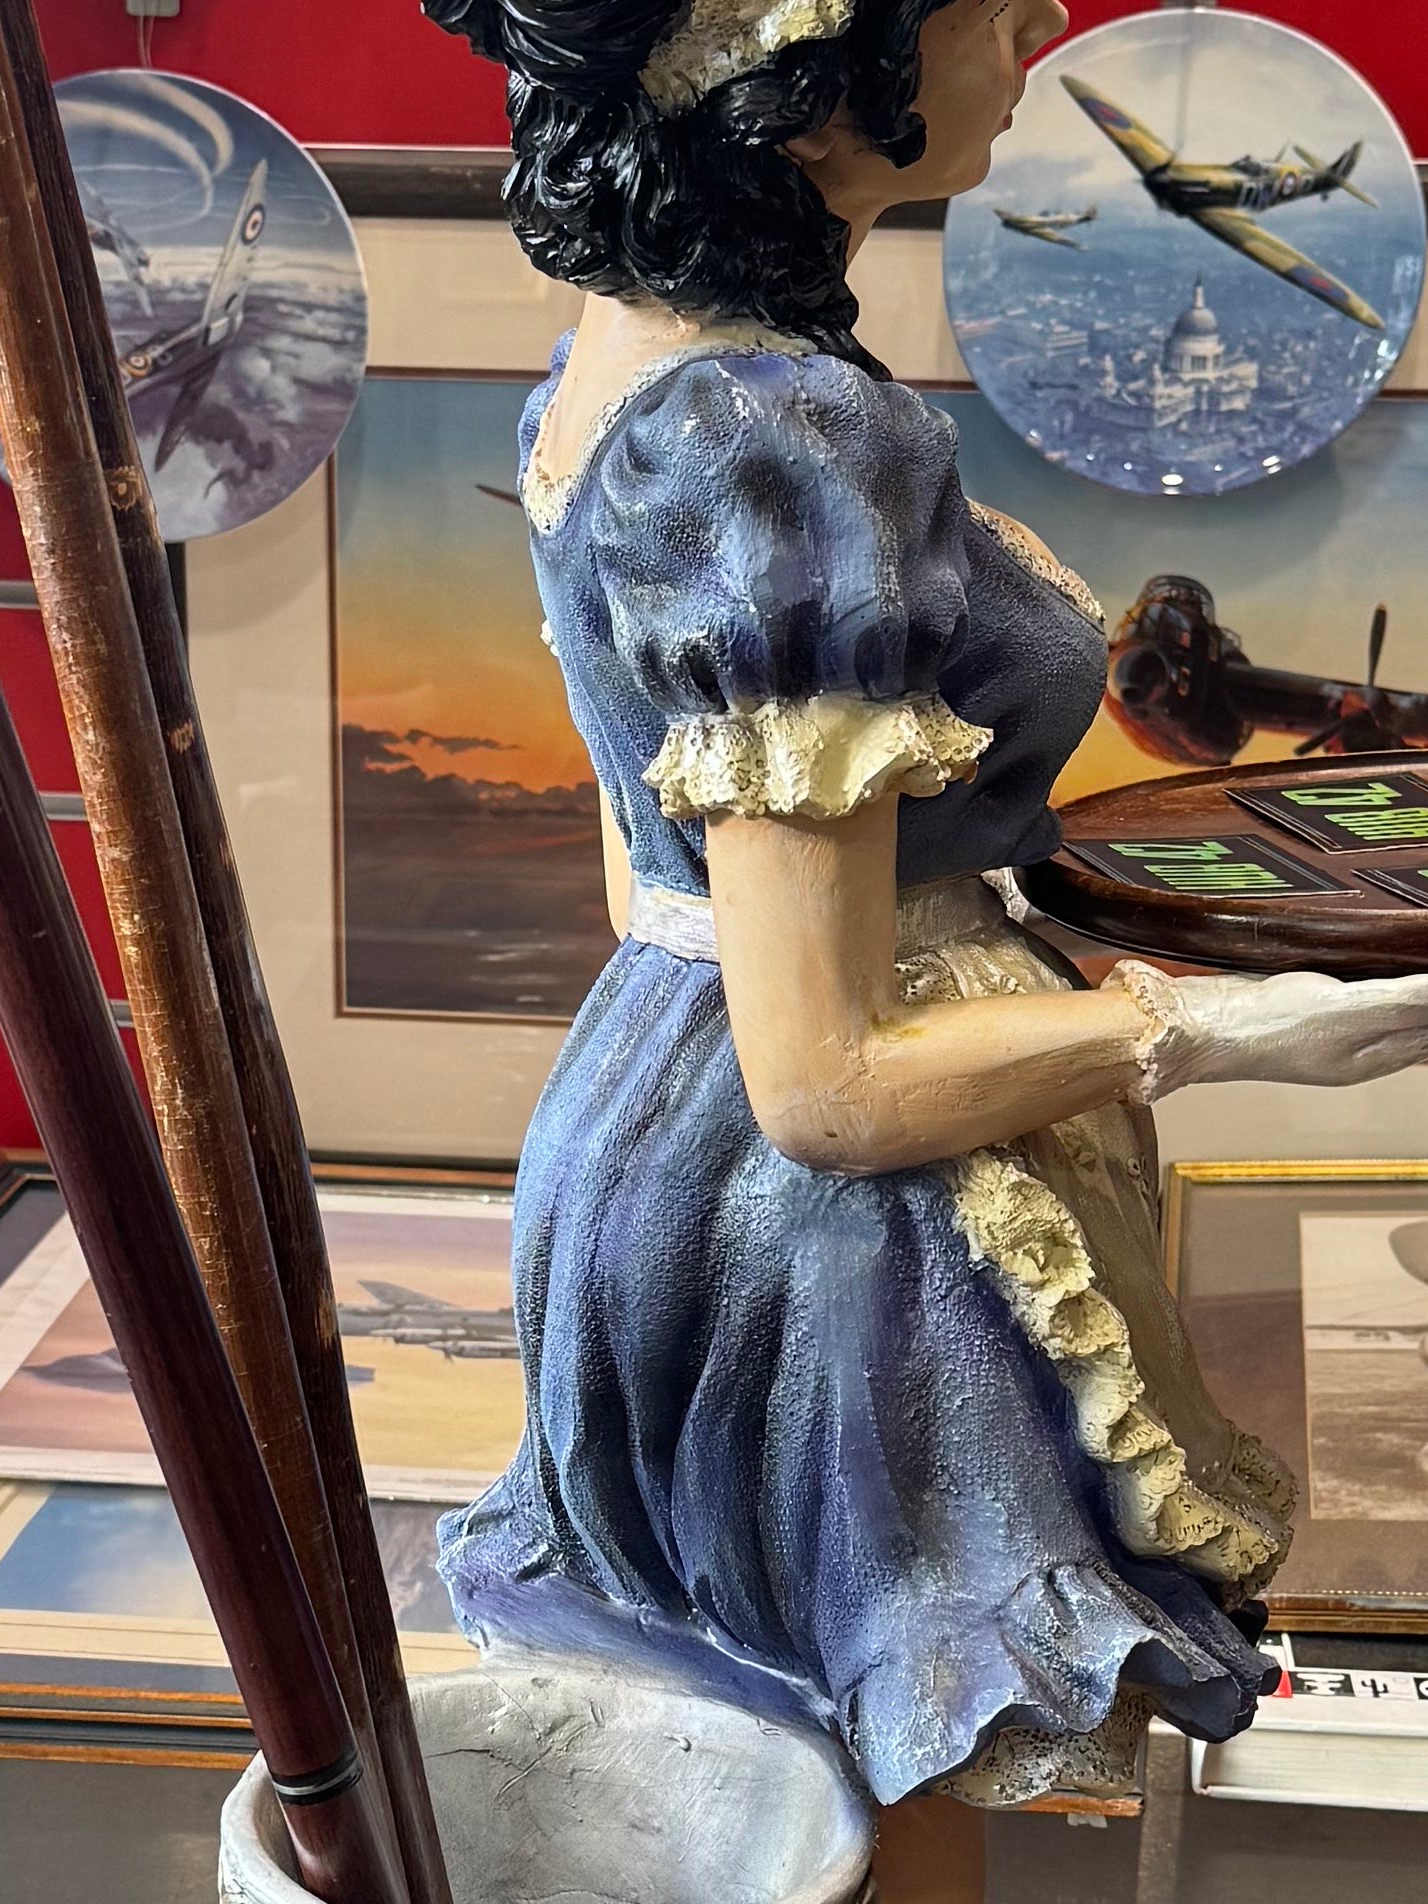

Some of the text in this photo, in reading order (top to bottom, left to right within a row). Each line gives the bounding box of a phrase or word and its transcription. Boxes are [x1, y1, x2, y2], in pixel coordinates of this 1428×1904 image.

[1280, 782, 1403, 806] 42
[1107, 841, 1294, 890] HUB 42
